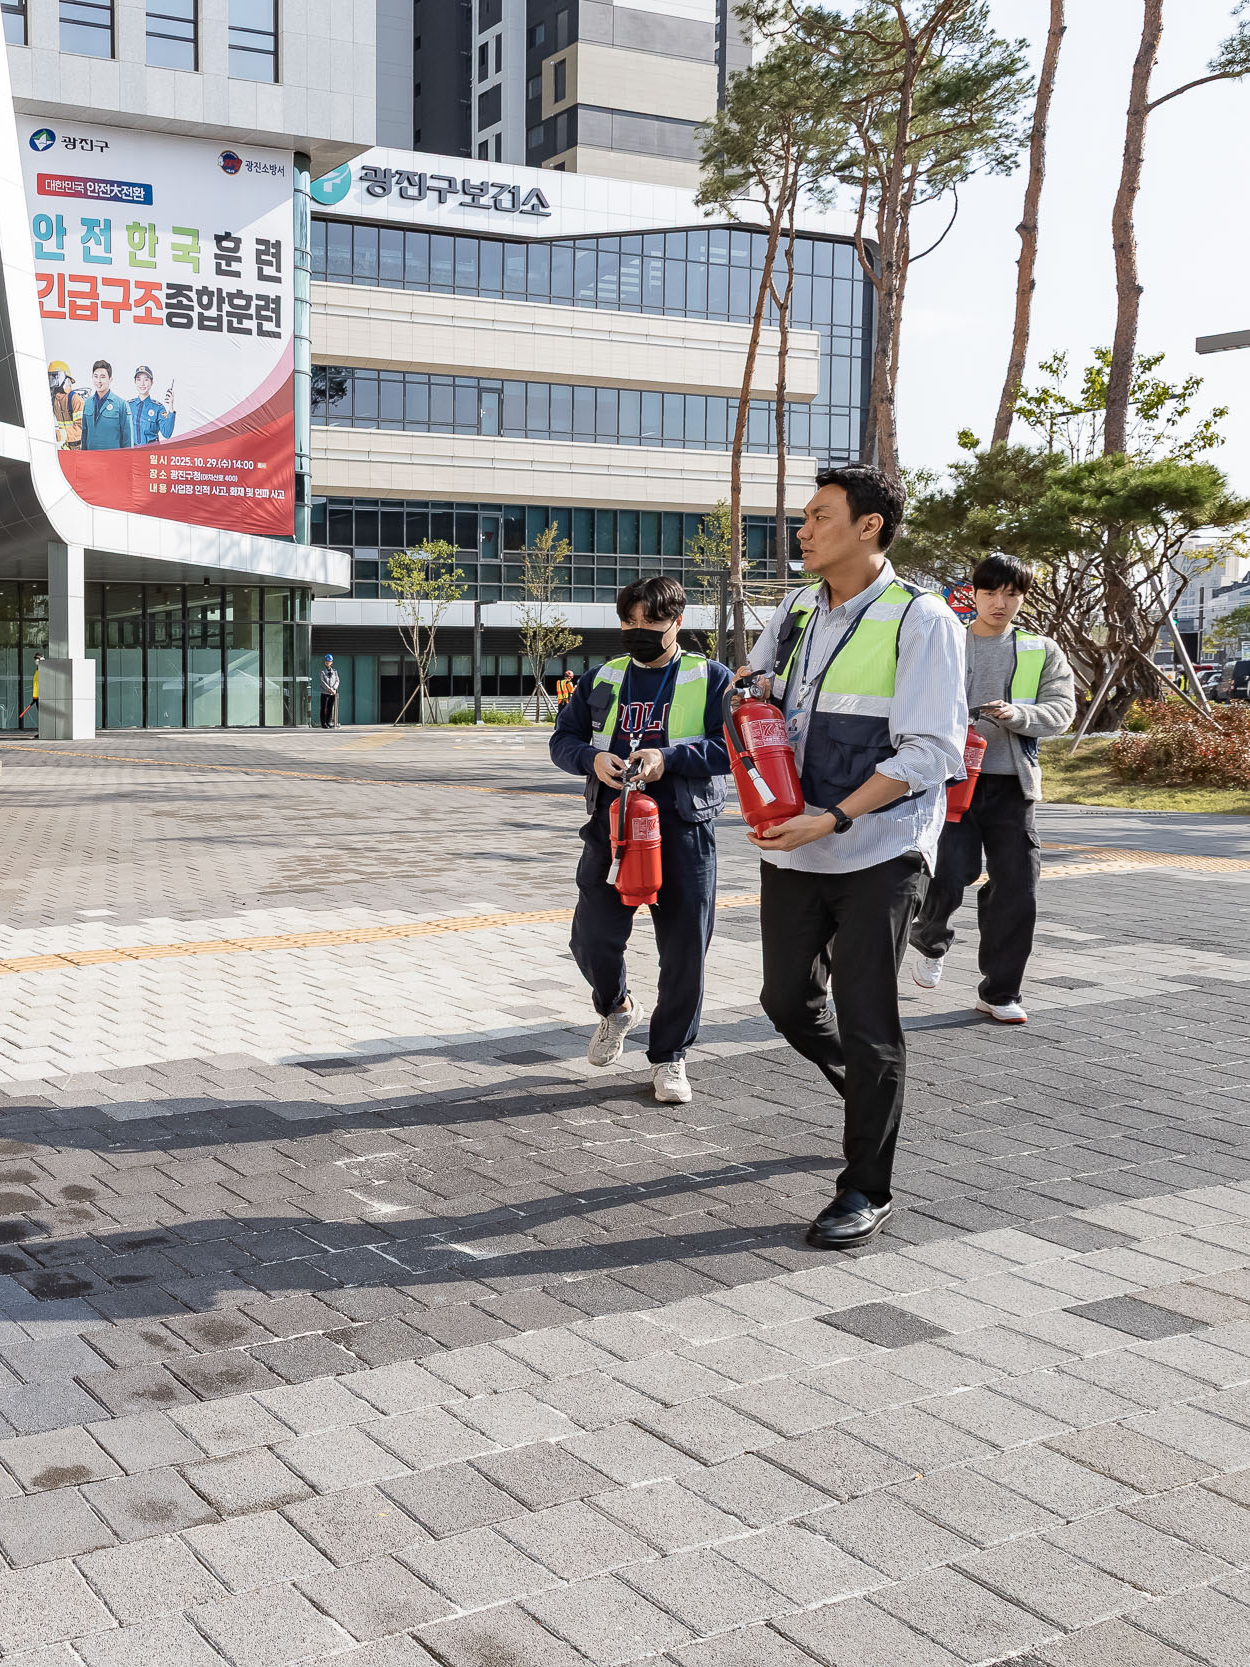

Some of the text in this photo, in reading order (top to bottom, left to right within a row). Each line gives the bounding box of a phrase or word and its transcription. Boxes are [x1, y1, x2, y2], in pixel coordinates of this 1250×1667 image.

[61, 135, 110, 153] 광진구
[245, 160, 285, 177] 광진소방서
[45, 178, 145, 201] 대한민국 안전大전환
[360, 165, 551, 217] 광진구보건소
[170, 456, 193, 466] 2025.
[194, 457, 206, 467] 10.
[232, 459, 254, 470] 14:00
[170, 484, 194, 495] 사업장
[195, 485, 210, 496] 인적
[230, 487, 244, 497] 화재
[246, 487, 254, 497] 및
[270, 489, 285, 500] 사고
